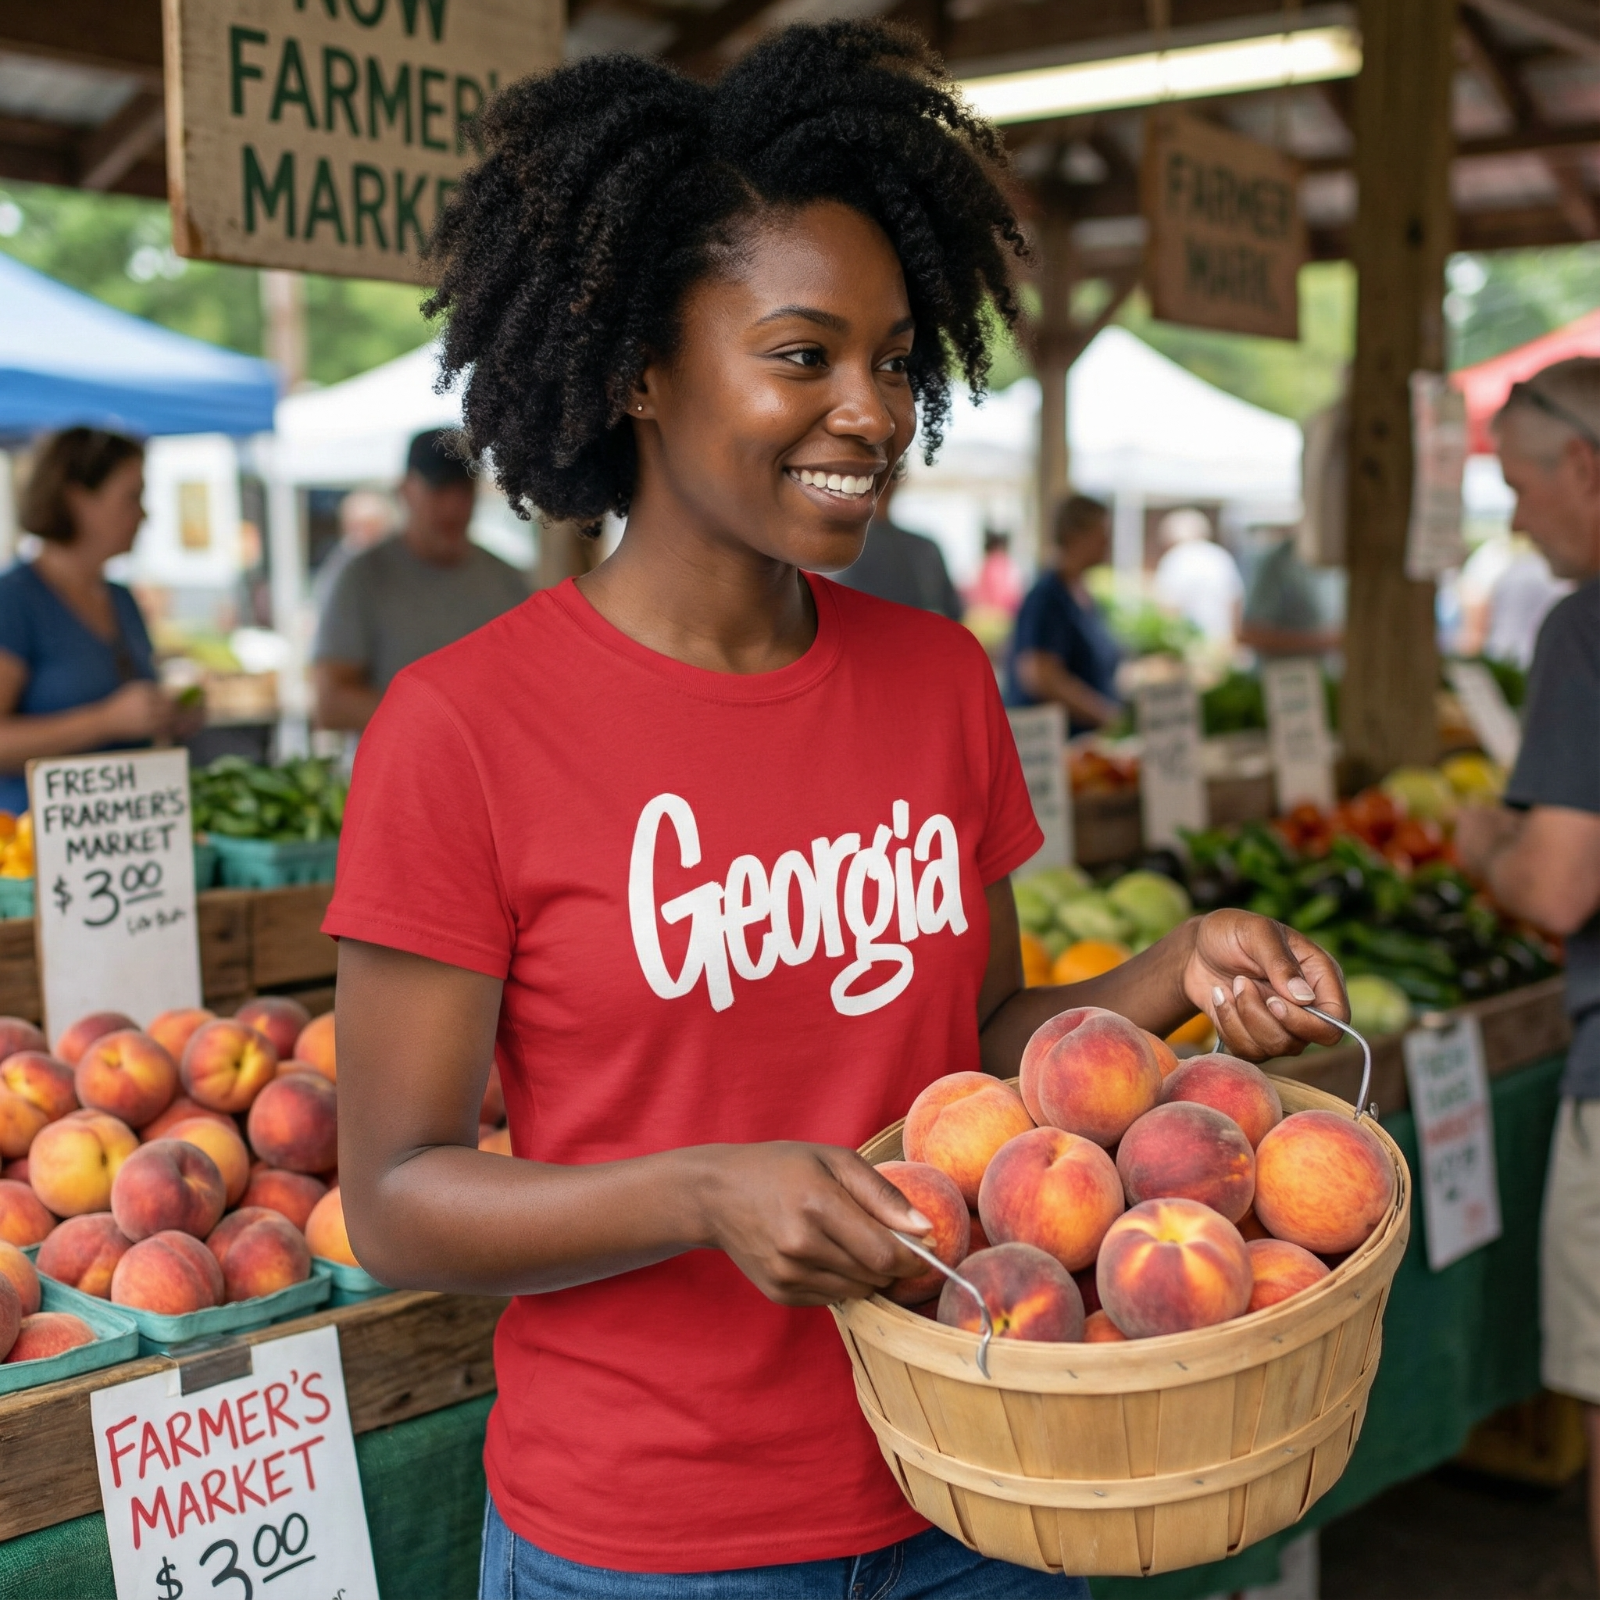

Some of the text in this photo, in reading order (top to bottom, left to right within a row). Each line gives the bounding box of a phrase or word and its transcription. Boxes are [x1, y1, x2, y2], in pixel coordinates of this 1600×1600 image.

[228, 24, 500, 158] FARMER'
[46, 762, 136, 799] FRESH
[66, 823, 176, 864] MARKET
[628, 793, 968, 1016] Georgia
[105, 1369, 332, 1489] FARMER'S
[130, 1435, 325, 1550] MARKET
